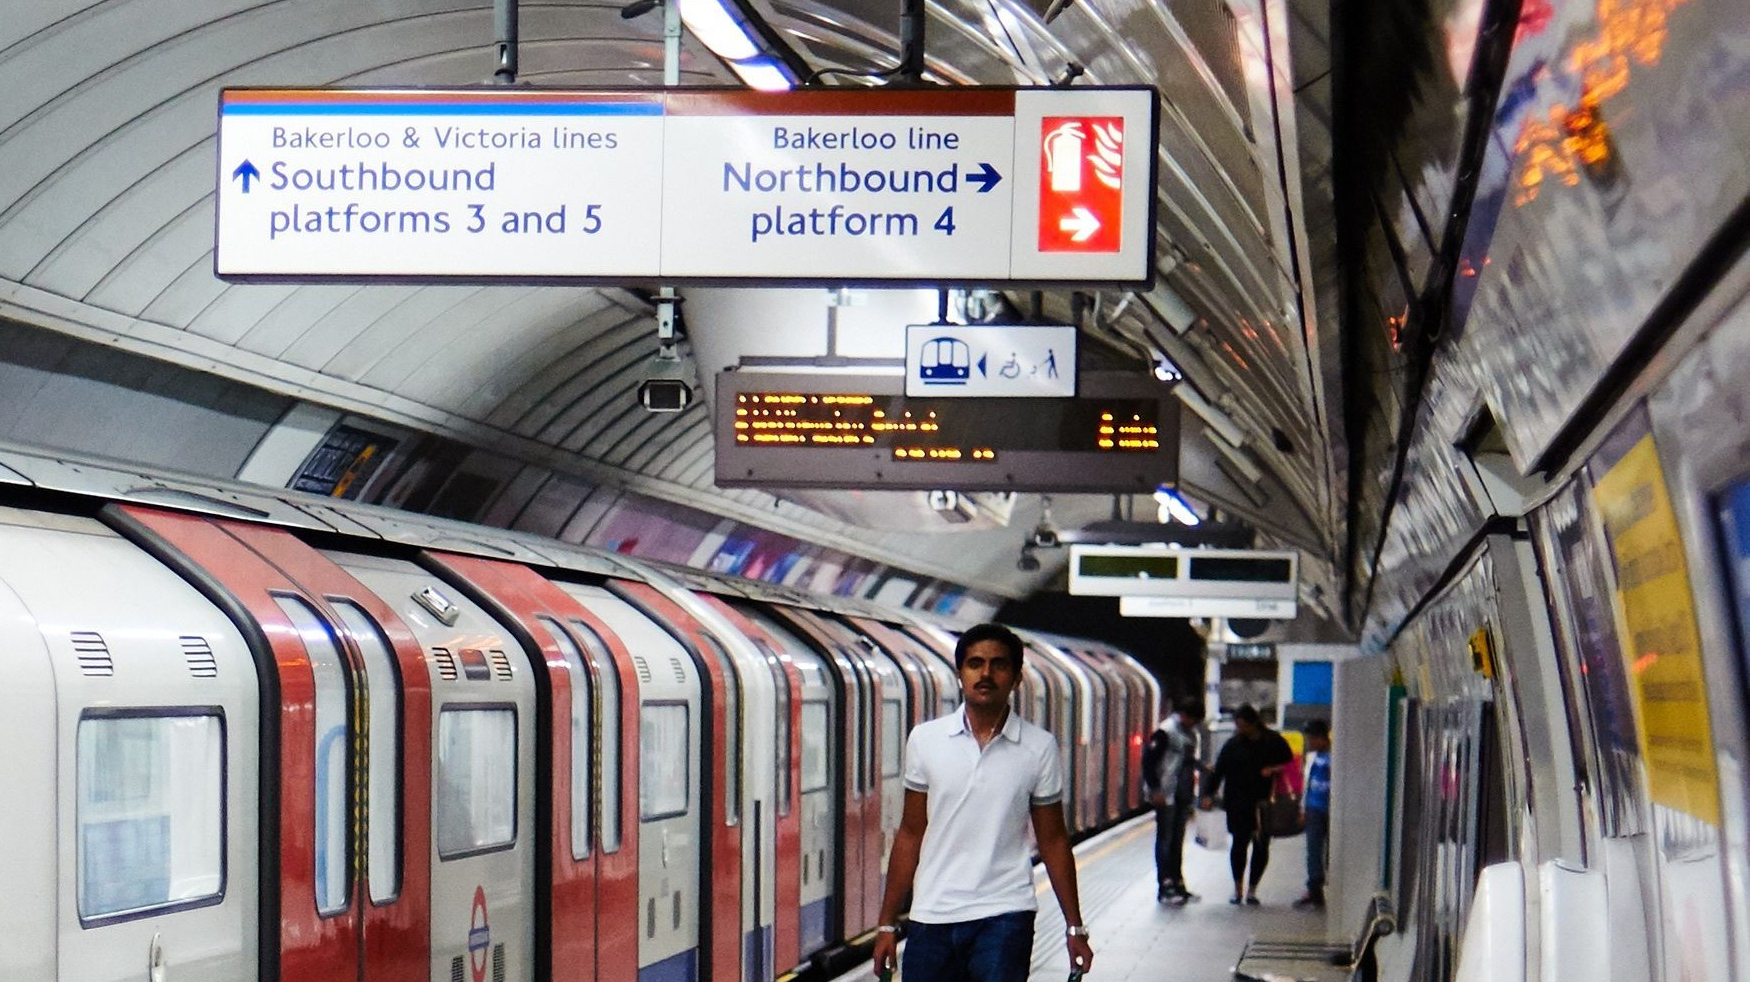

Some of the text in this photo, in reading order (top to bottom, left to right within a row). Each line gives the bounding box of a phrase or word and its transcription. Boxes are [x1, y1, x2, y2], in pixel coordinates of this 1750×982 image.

[272, 126, 618, 149] Bakerloo & Victoria lines
[773, 126, 960, 150] Bakerloo line
[270, 160, 496, 191] Southbound
[722, 161, 958, 193] Northbound
[270, 202, 602, 240] platforms 3 and 5
[751, 204, 956, 243] platform 4
